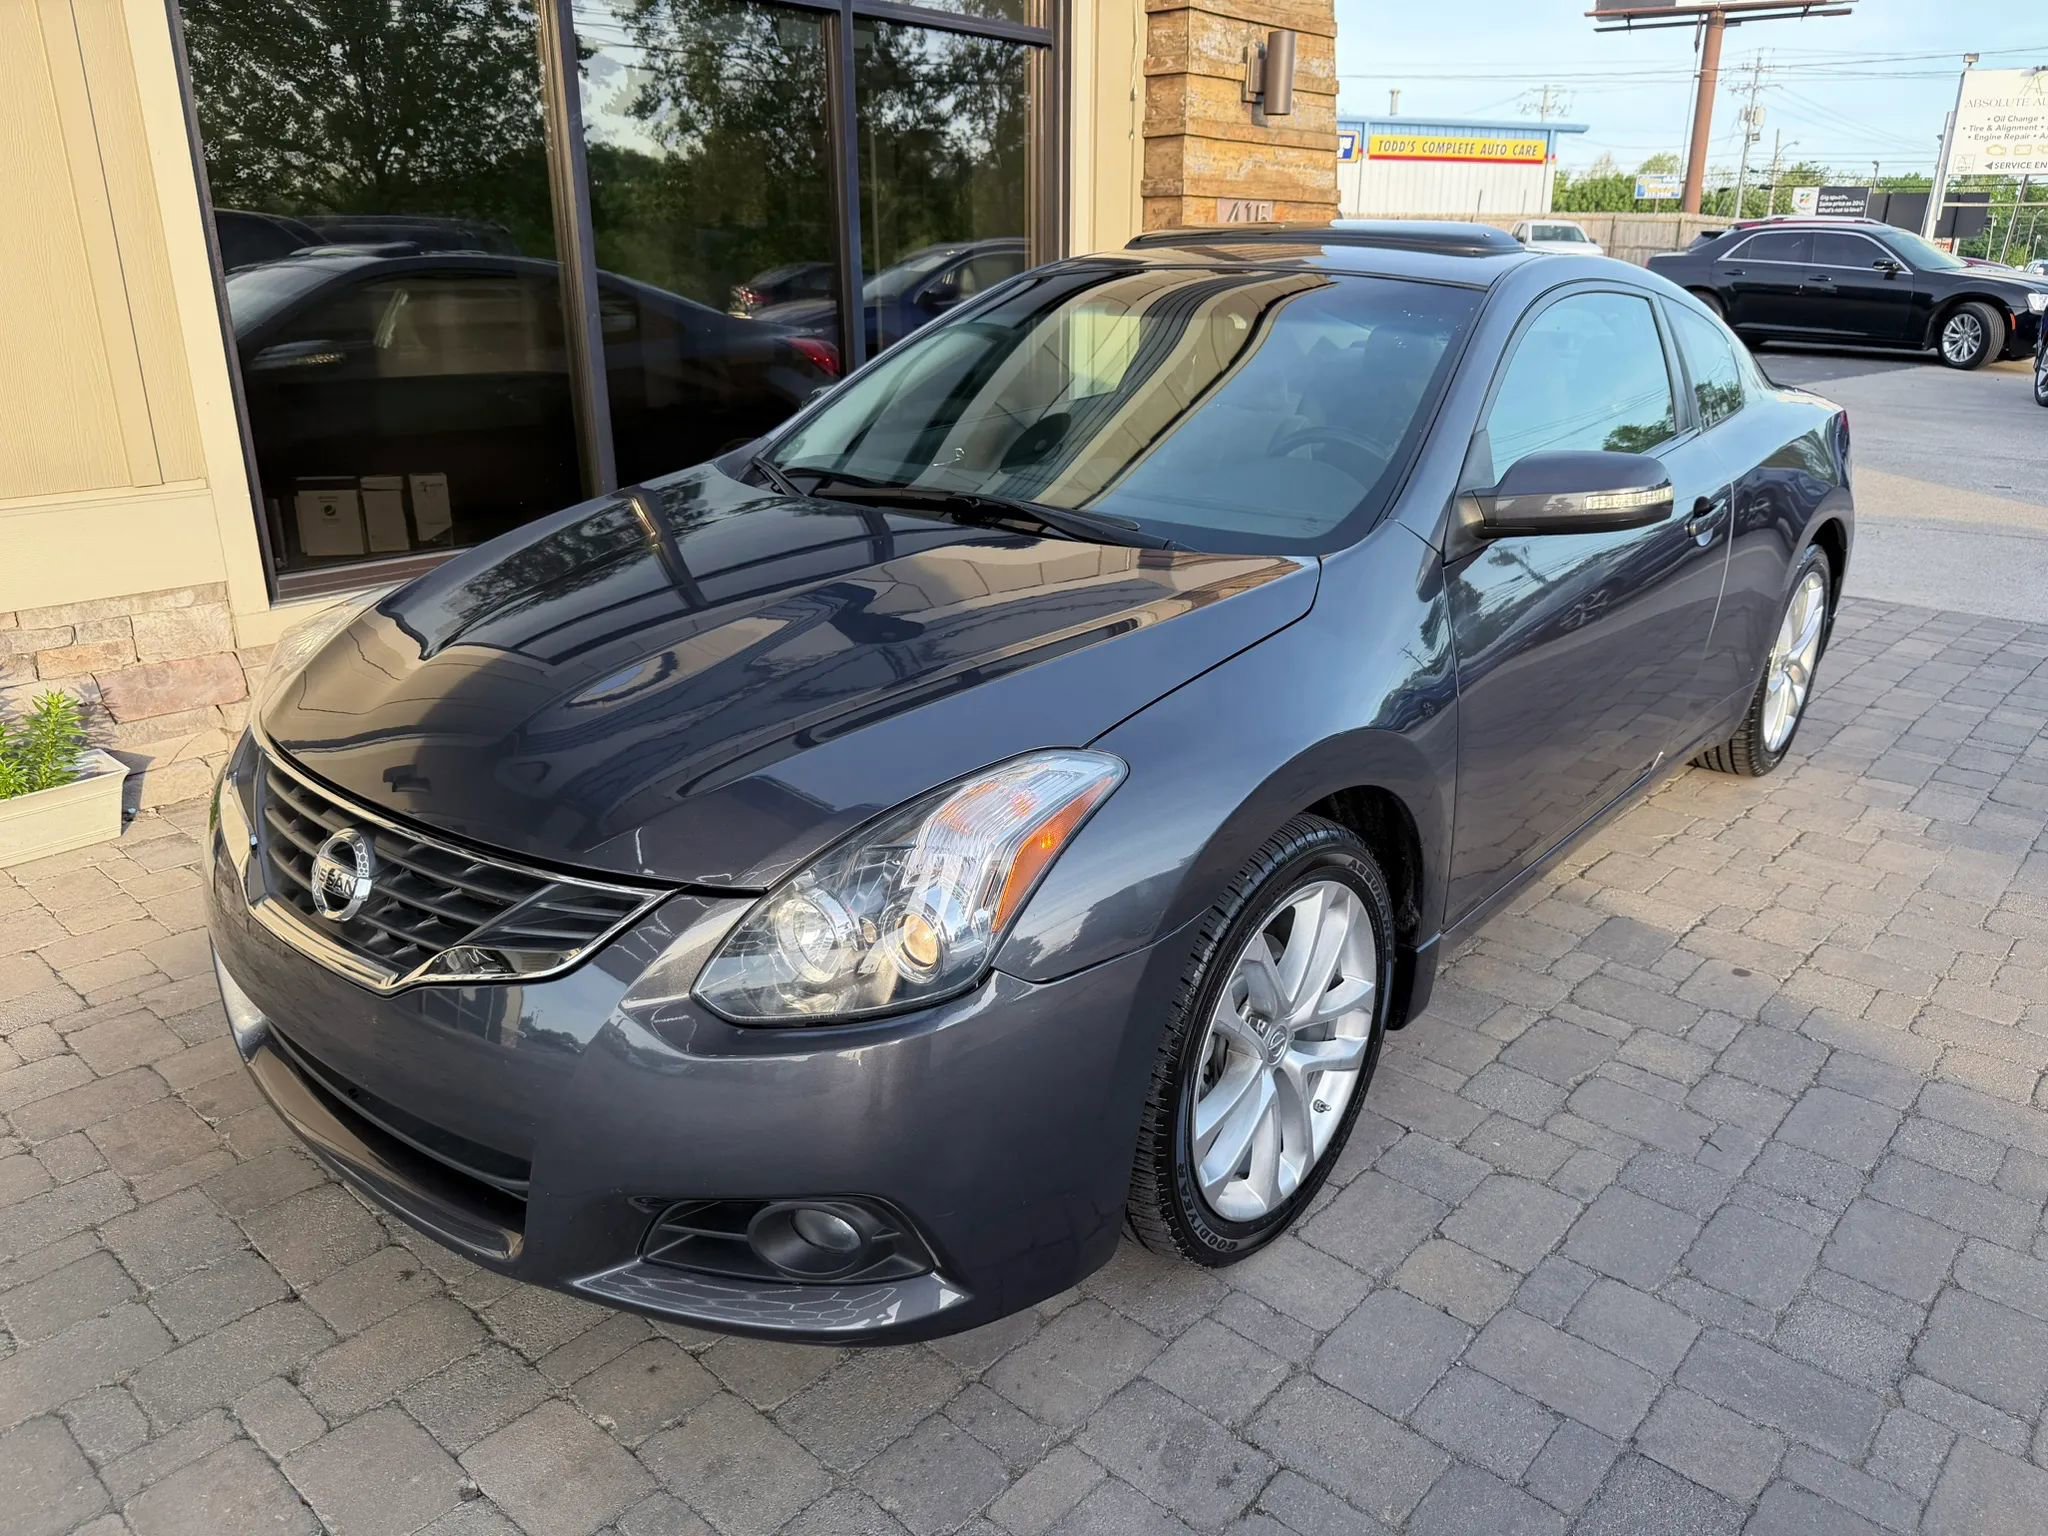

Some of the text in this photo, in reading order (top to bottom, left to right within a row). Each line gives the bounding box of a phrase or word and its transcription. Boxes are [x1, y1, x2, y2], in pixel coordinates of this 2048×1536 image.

[1965, 98, 2030, 108] ABSOLUTE
[2007, 115, 2038, 124] Change
[1995, 124, 2037, 133] Alignment
[1974, 133, 2001, 142] Engine
[2004, 132, 2031, 142] Repair
[1378, 140, 1538, 157] TODD'S COMPLETE AUTO CARE
[1994, 161, 2032, 170] SERVICE
[1227, 201, 1270, 223] 415
[315, 863, 360, 899] SSAN
[1177, 1162, 1239, 1252] GOODYEAR
